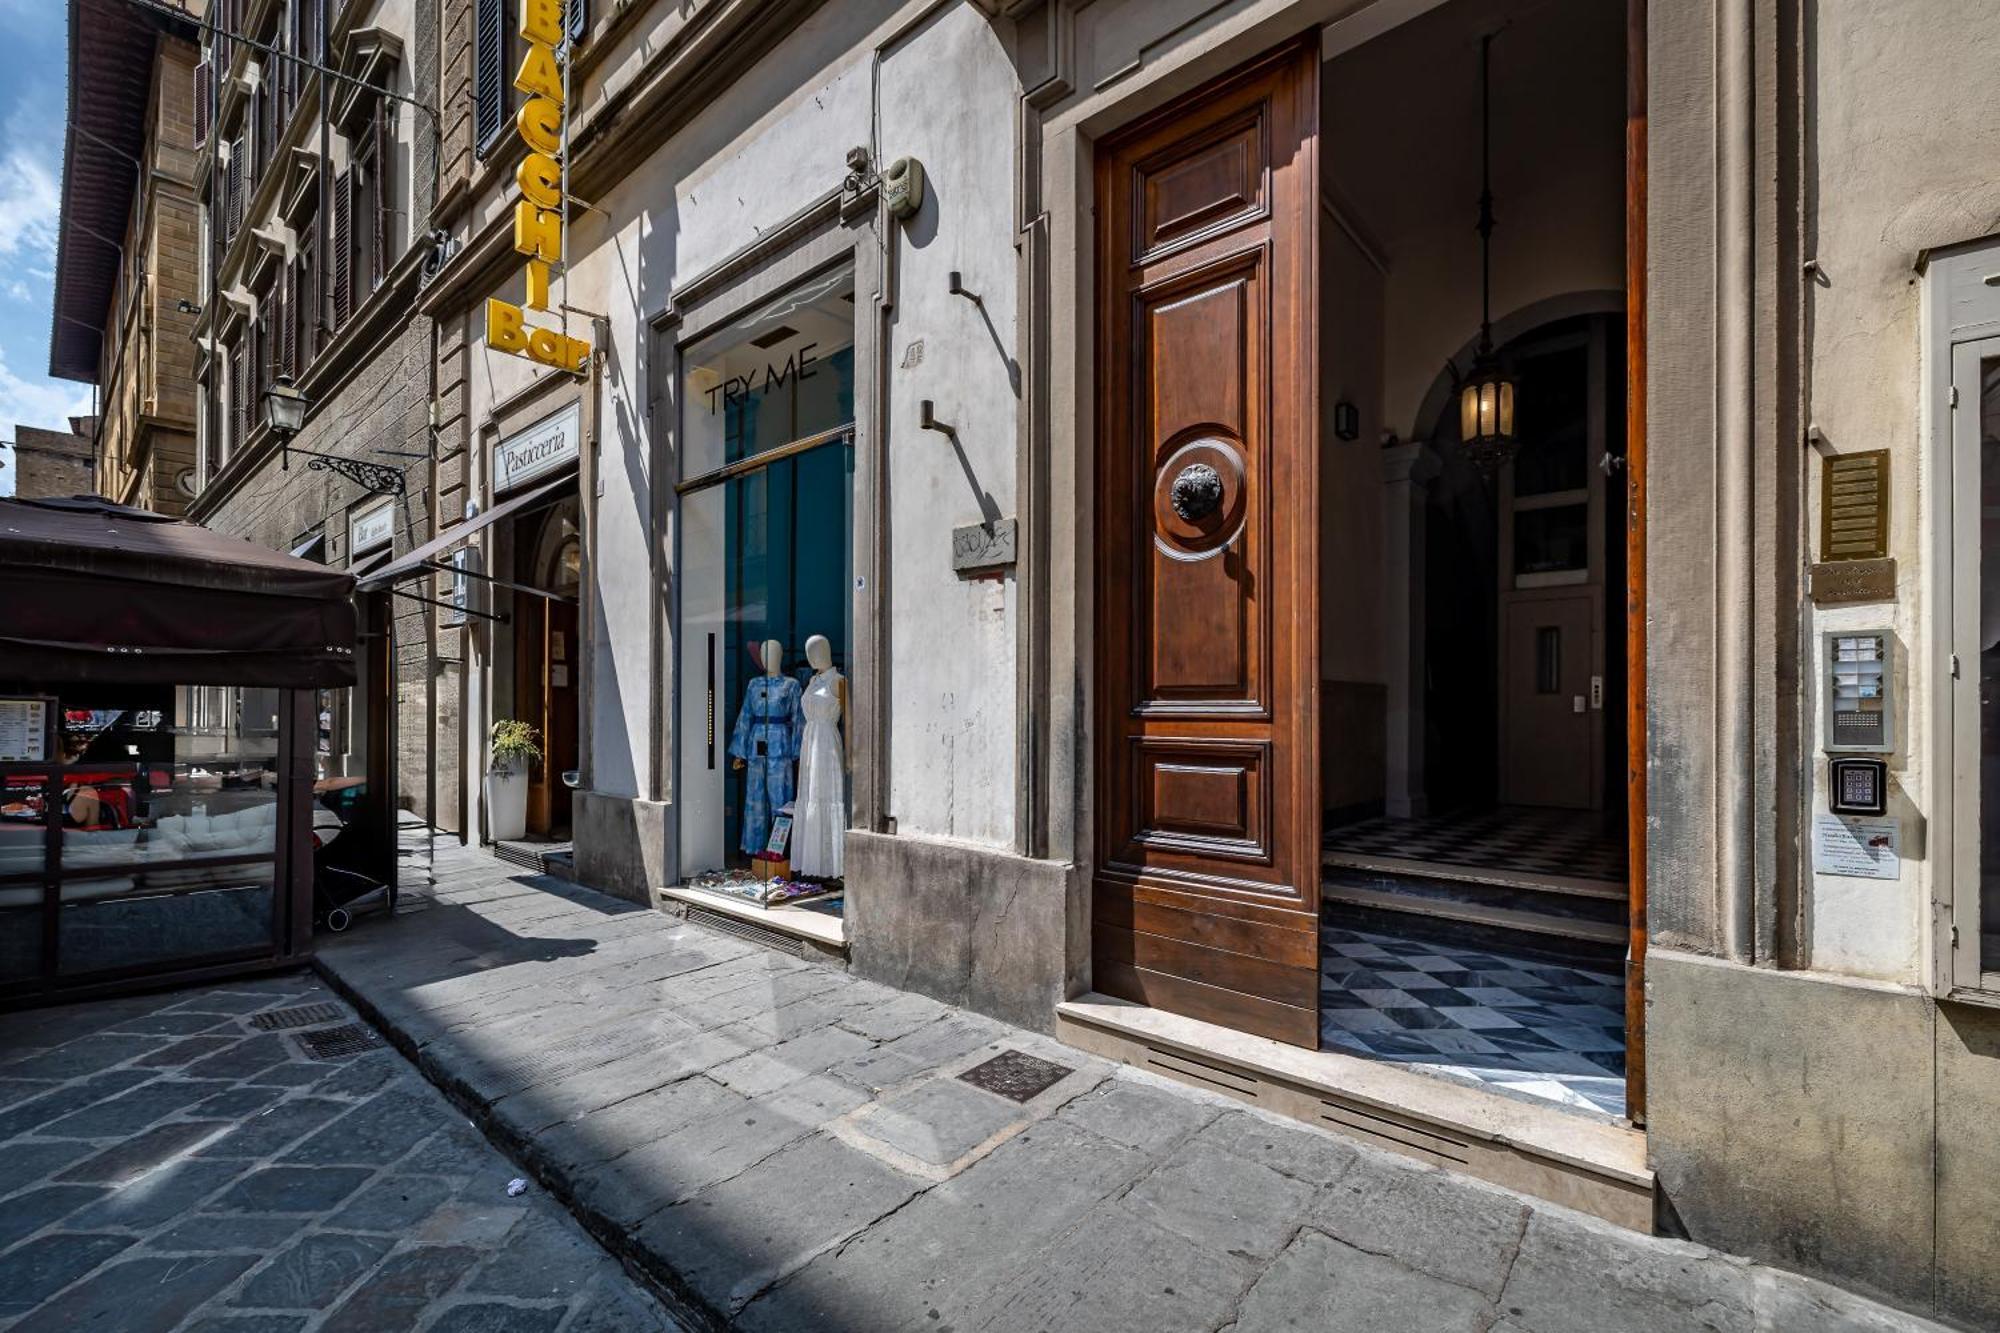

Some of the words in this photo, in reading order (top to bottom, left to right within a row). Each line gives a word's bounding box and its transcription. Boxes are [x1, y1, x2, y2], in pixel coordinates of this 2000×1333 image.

[487, 298, 591, 373] Bar
[704, 368, 757, 416] TRY
[764, 341, 818, 396] ME
[506, 426, 566, 473] Pasticceria
